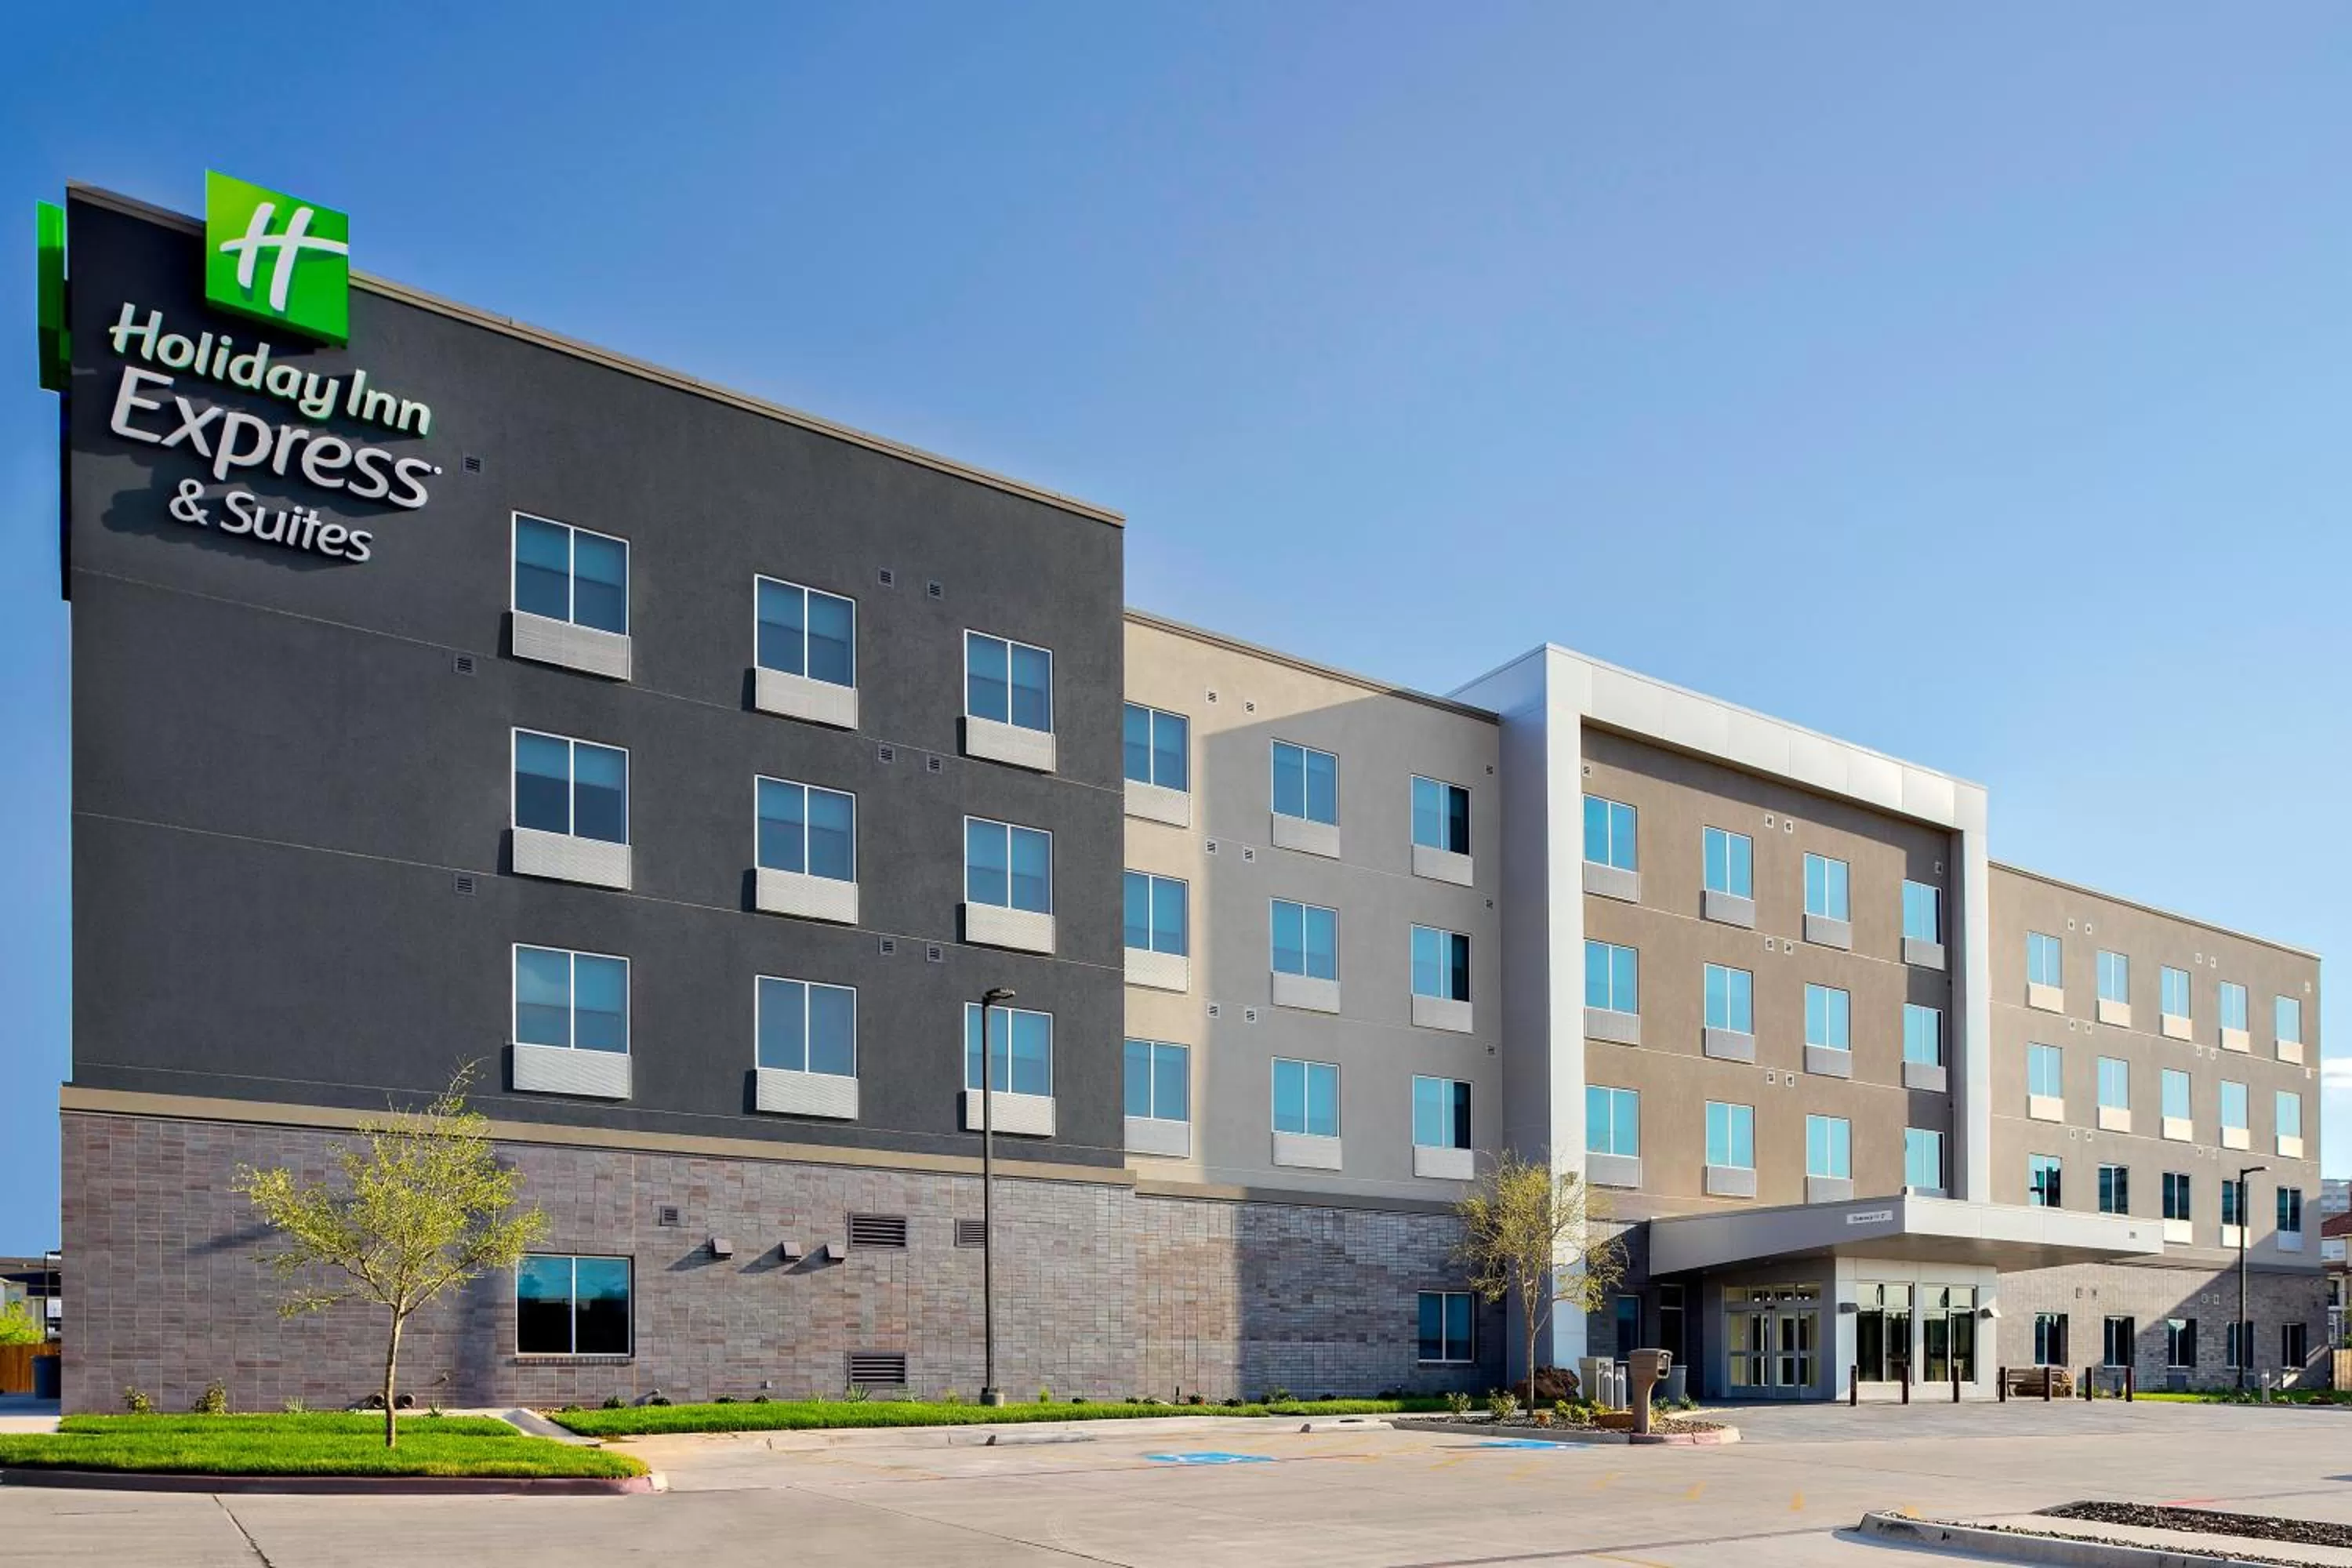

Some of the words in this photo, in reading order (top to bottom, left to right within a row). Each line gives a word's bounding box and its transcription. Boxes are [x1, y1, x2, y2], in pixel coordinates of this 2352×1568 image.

[219, 202, 348, 312] H
[109, 302, 339, 419] Holiday
[347, 369, 431, 436] Inn
[110, 366, 430, 509] Express
[169, 478, 207, 526] &
[220, 491, 373, 561] Suites
